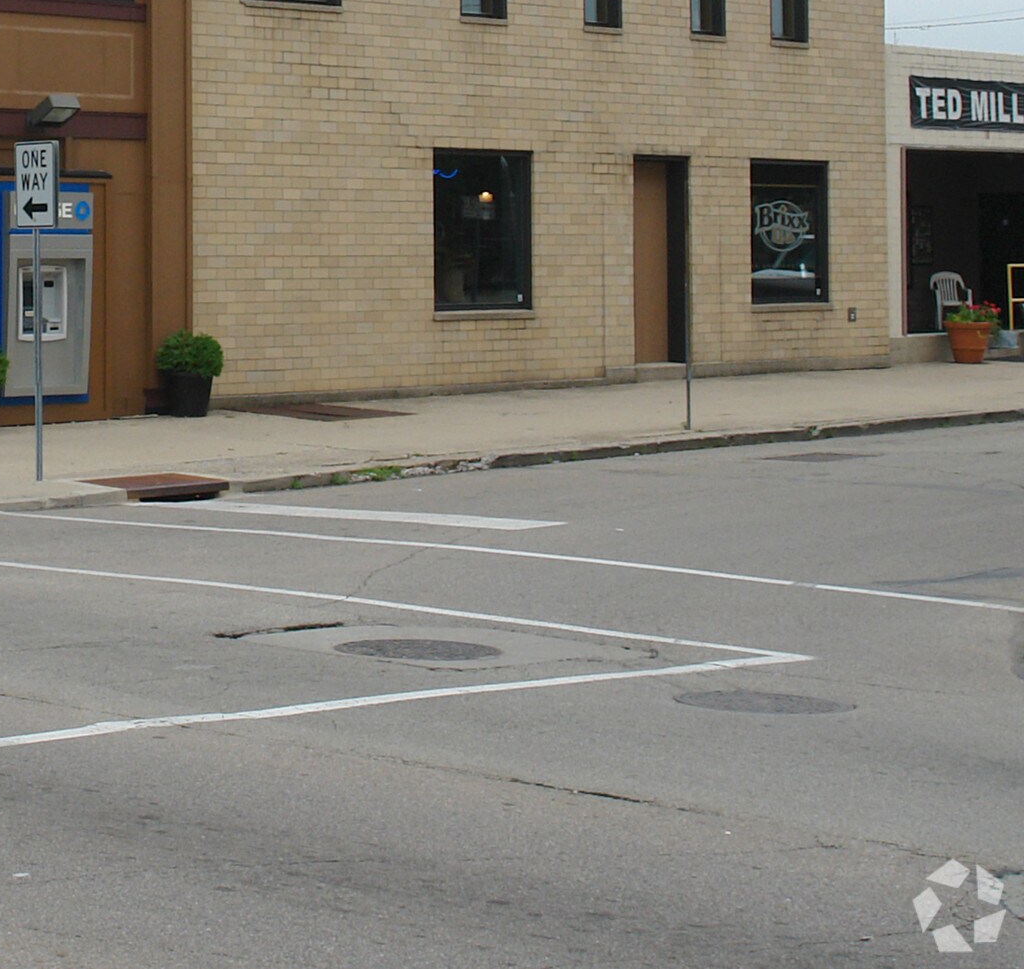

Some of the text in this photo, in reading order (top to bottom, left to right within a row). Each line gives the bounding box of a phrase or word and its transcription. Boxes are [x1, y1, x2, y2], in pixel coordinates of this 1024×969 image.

[915, 87, 1024, 124] TED MILL
[22, 150, 47, 169] ONE
[21, 172, 48, 191] WAY
[759, 205, 807, 229] Brixx
